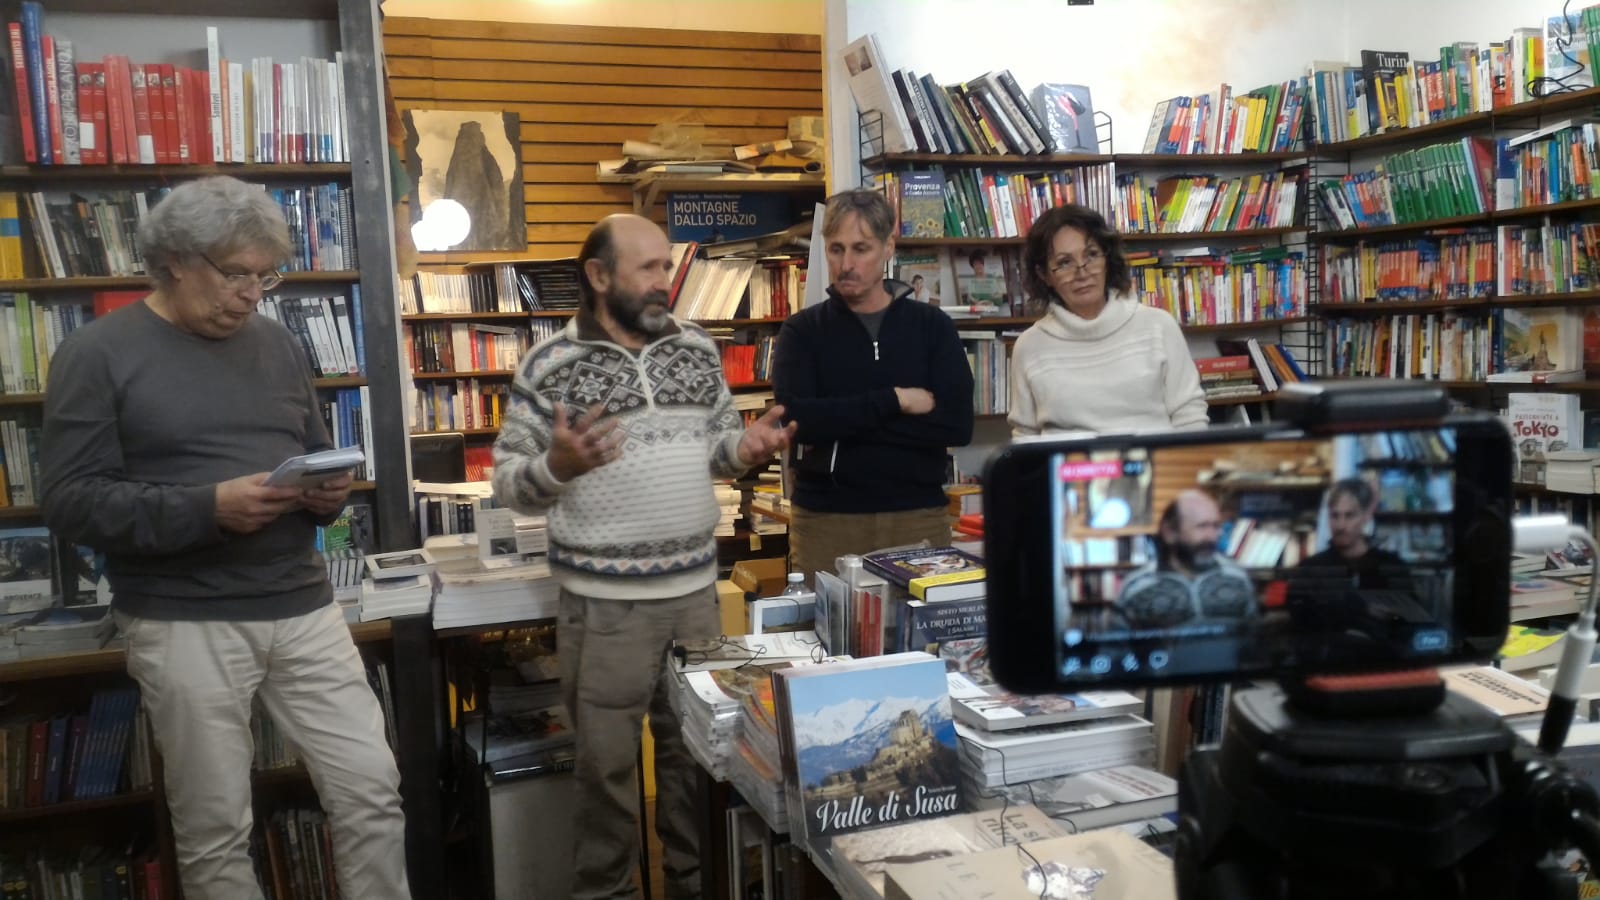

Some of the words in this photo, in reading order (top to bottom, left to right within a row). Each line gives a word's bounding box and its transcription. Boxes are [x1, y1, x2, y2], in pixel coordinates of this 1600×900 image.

[1376, 53, 1406, 67] Turin
[905, 183, 940, 191] Provenza
[673, 201, 739, 213] MONTAGNE
[674, 214, 714, 226] DALLO
[716, 214, 757, 226] SPAZIO
[958, 604, 986, 614] MERLIN
[916, 621, 928, 630] LA
[930, 618, 961, 629] DRUIDA
[962, 616, 971, 625] DI
[816, 795, 874, 832] Valle
[879, 790, 900, 822] di
[906, 785, 958, 817] Susa
